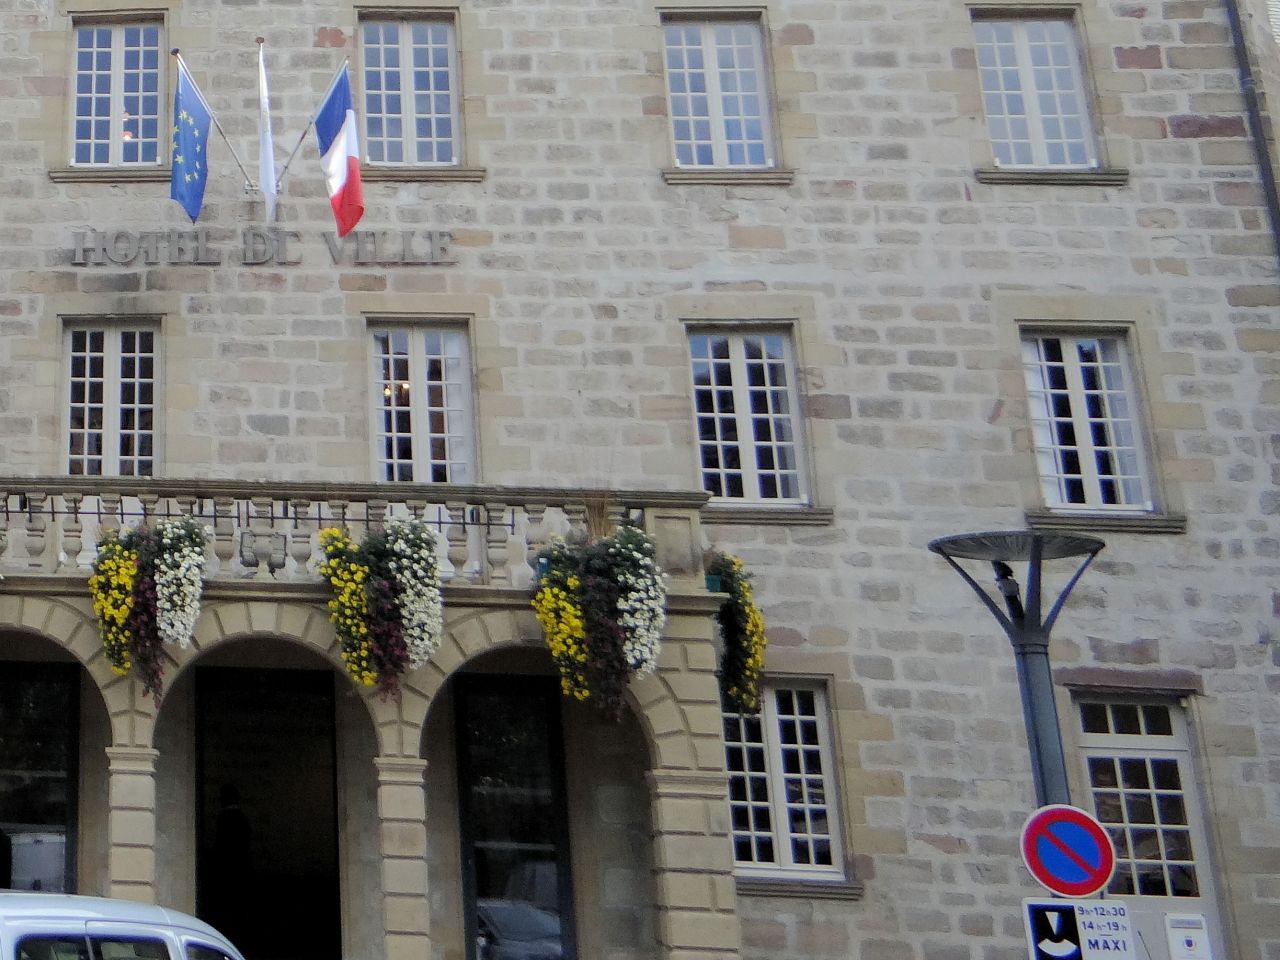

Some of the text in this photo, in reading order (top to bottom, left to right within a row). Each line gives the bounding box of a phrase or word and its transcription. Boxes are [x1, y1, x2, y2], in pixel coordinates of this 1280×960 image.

[241, 229, 303, 266] DE
[321, 230, 459, 266] VILLE
[1087, 939, 1127, 951] MAXI
